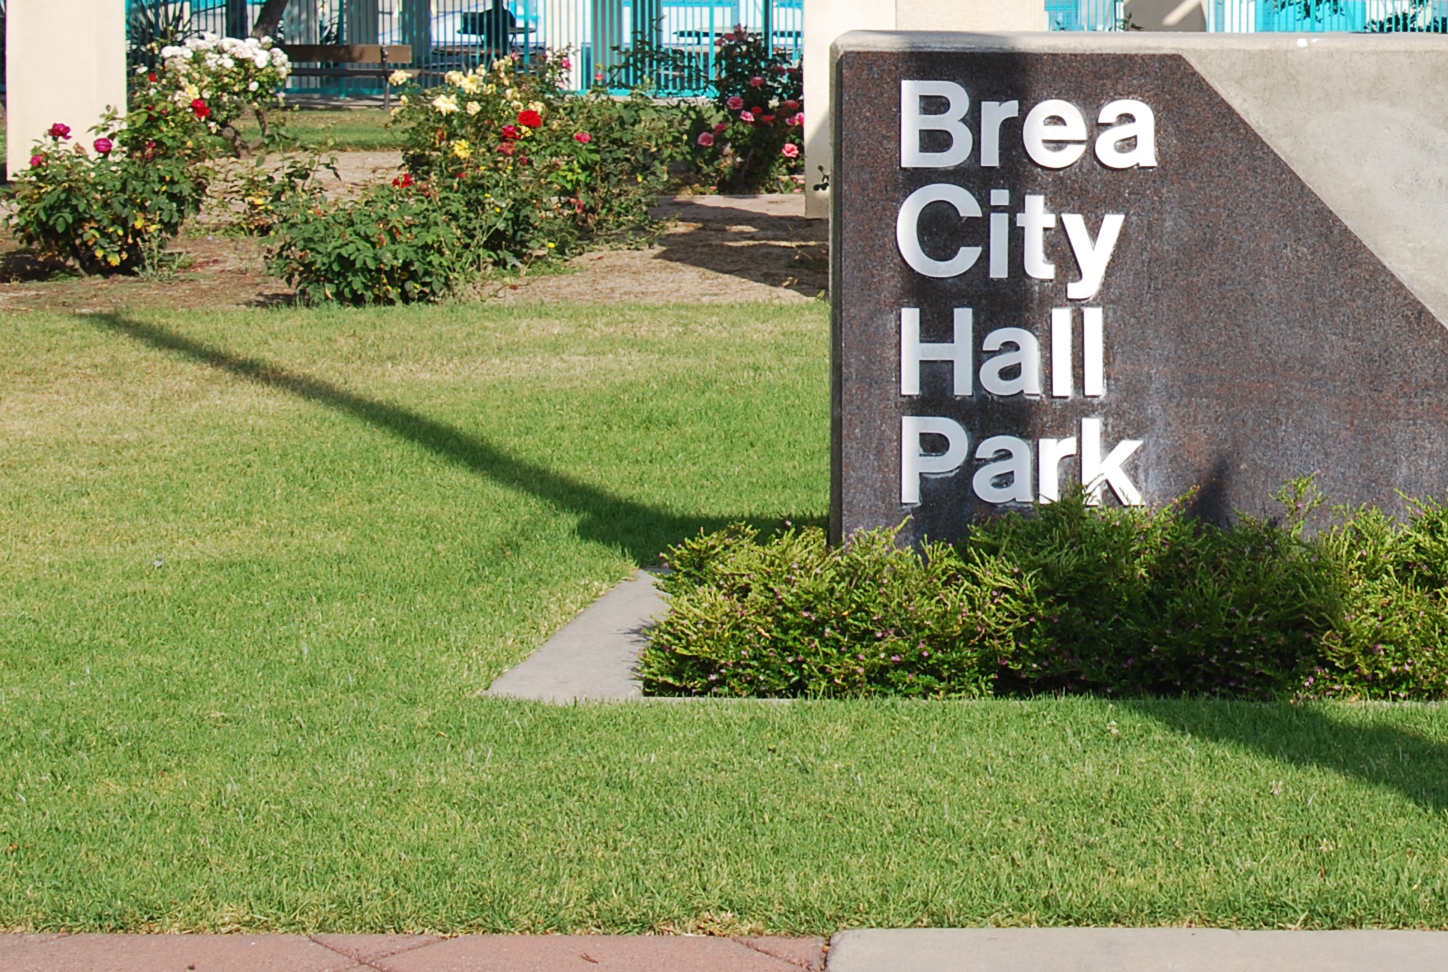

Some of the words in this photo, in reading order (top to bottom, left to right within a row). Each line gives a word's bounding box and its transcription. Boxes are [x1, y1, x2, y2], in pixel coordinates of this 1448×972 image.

[900, 79, 1157, 169] Brea
[896, 183, 1125, 300] City
[900, 307, 1104, 397] Hall
[901, 416, 1144, 506] Park
